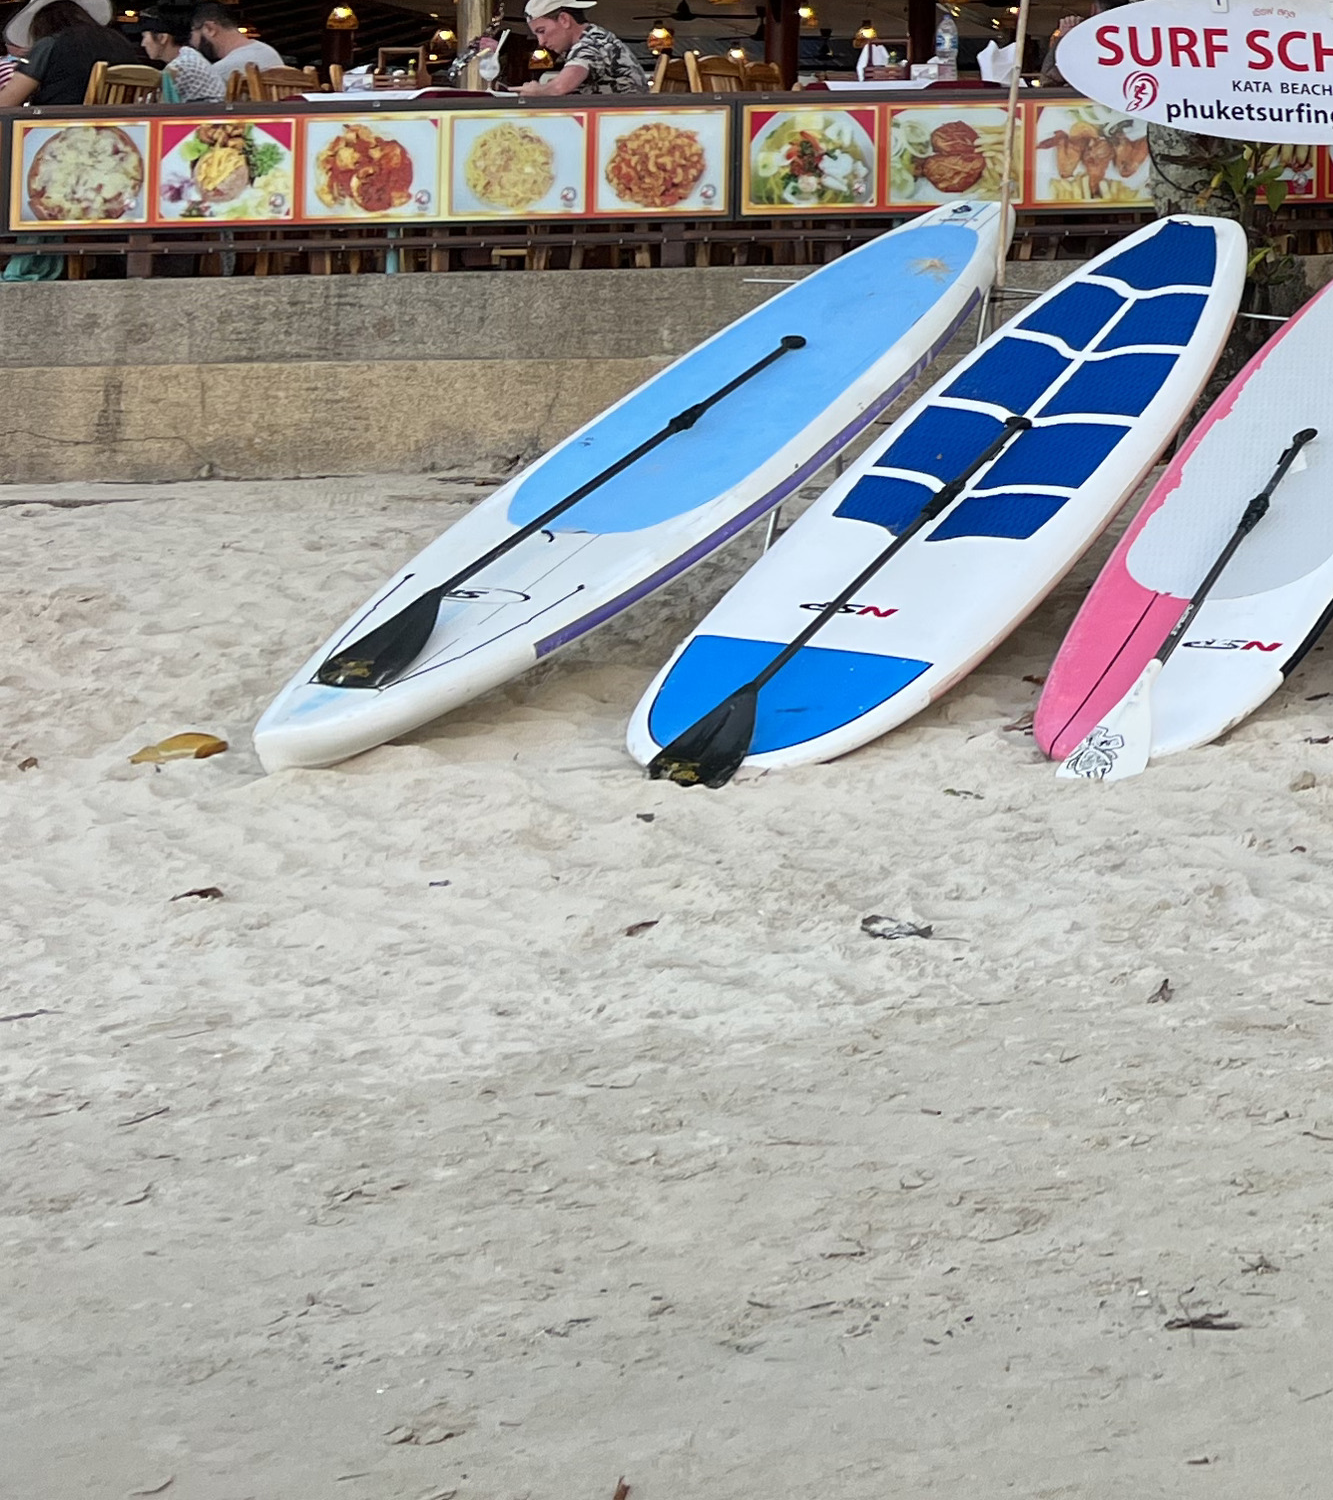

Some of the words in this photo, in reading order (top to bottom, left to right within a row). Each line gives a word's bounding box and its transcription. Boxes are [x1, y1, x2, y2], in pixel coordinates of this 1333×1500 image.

[1096, 25, 1229, 68] SURF
[1232, 80, 1272, 94] KATA
[1280, 82, 1333, 96] BEACH
